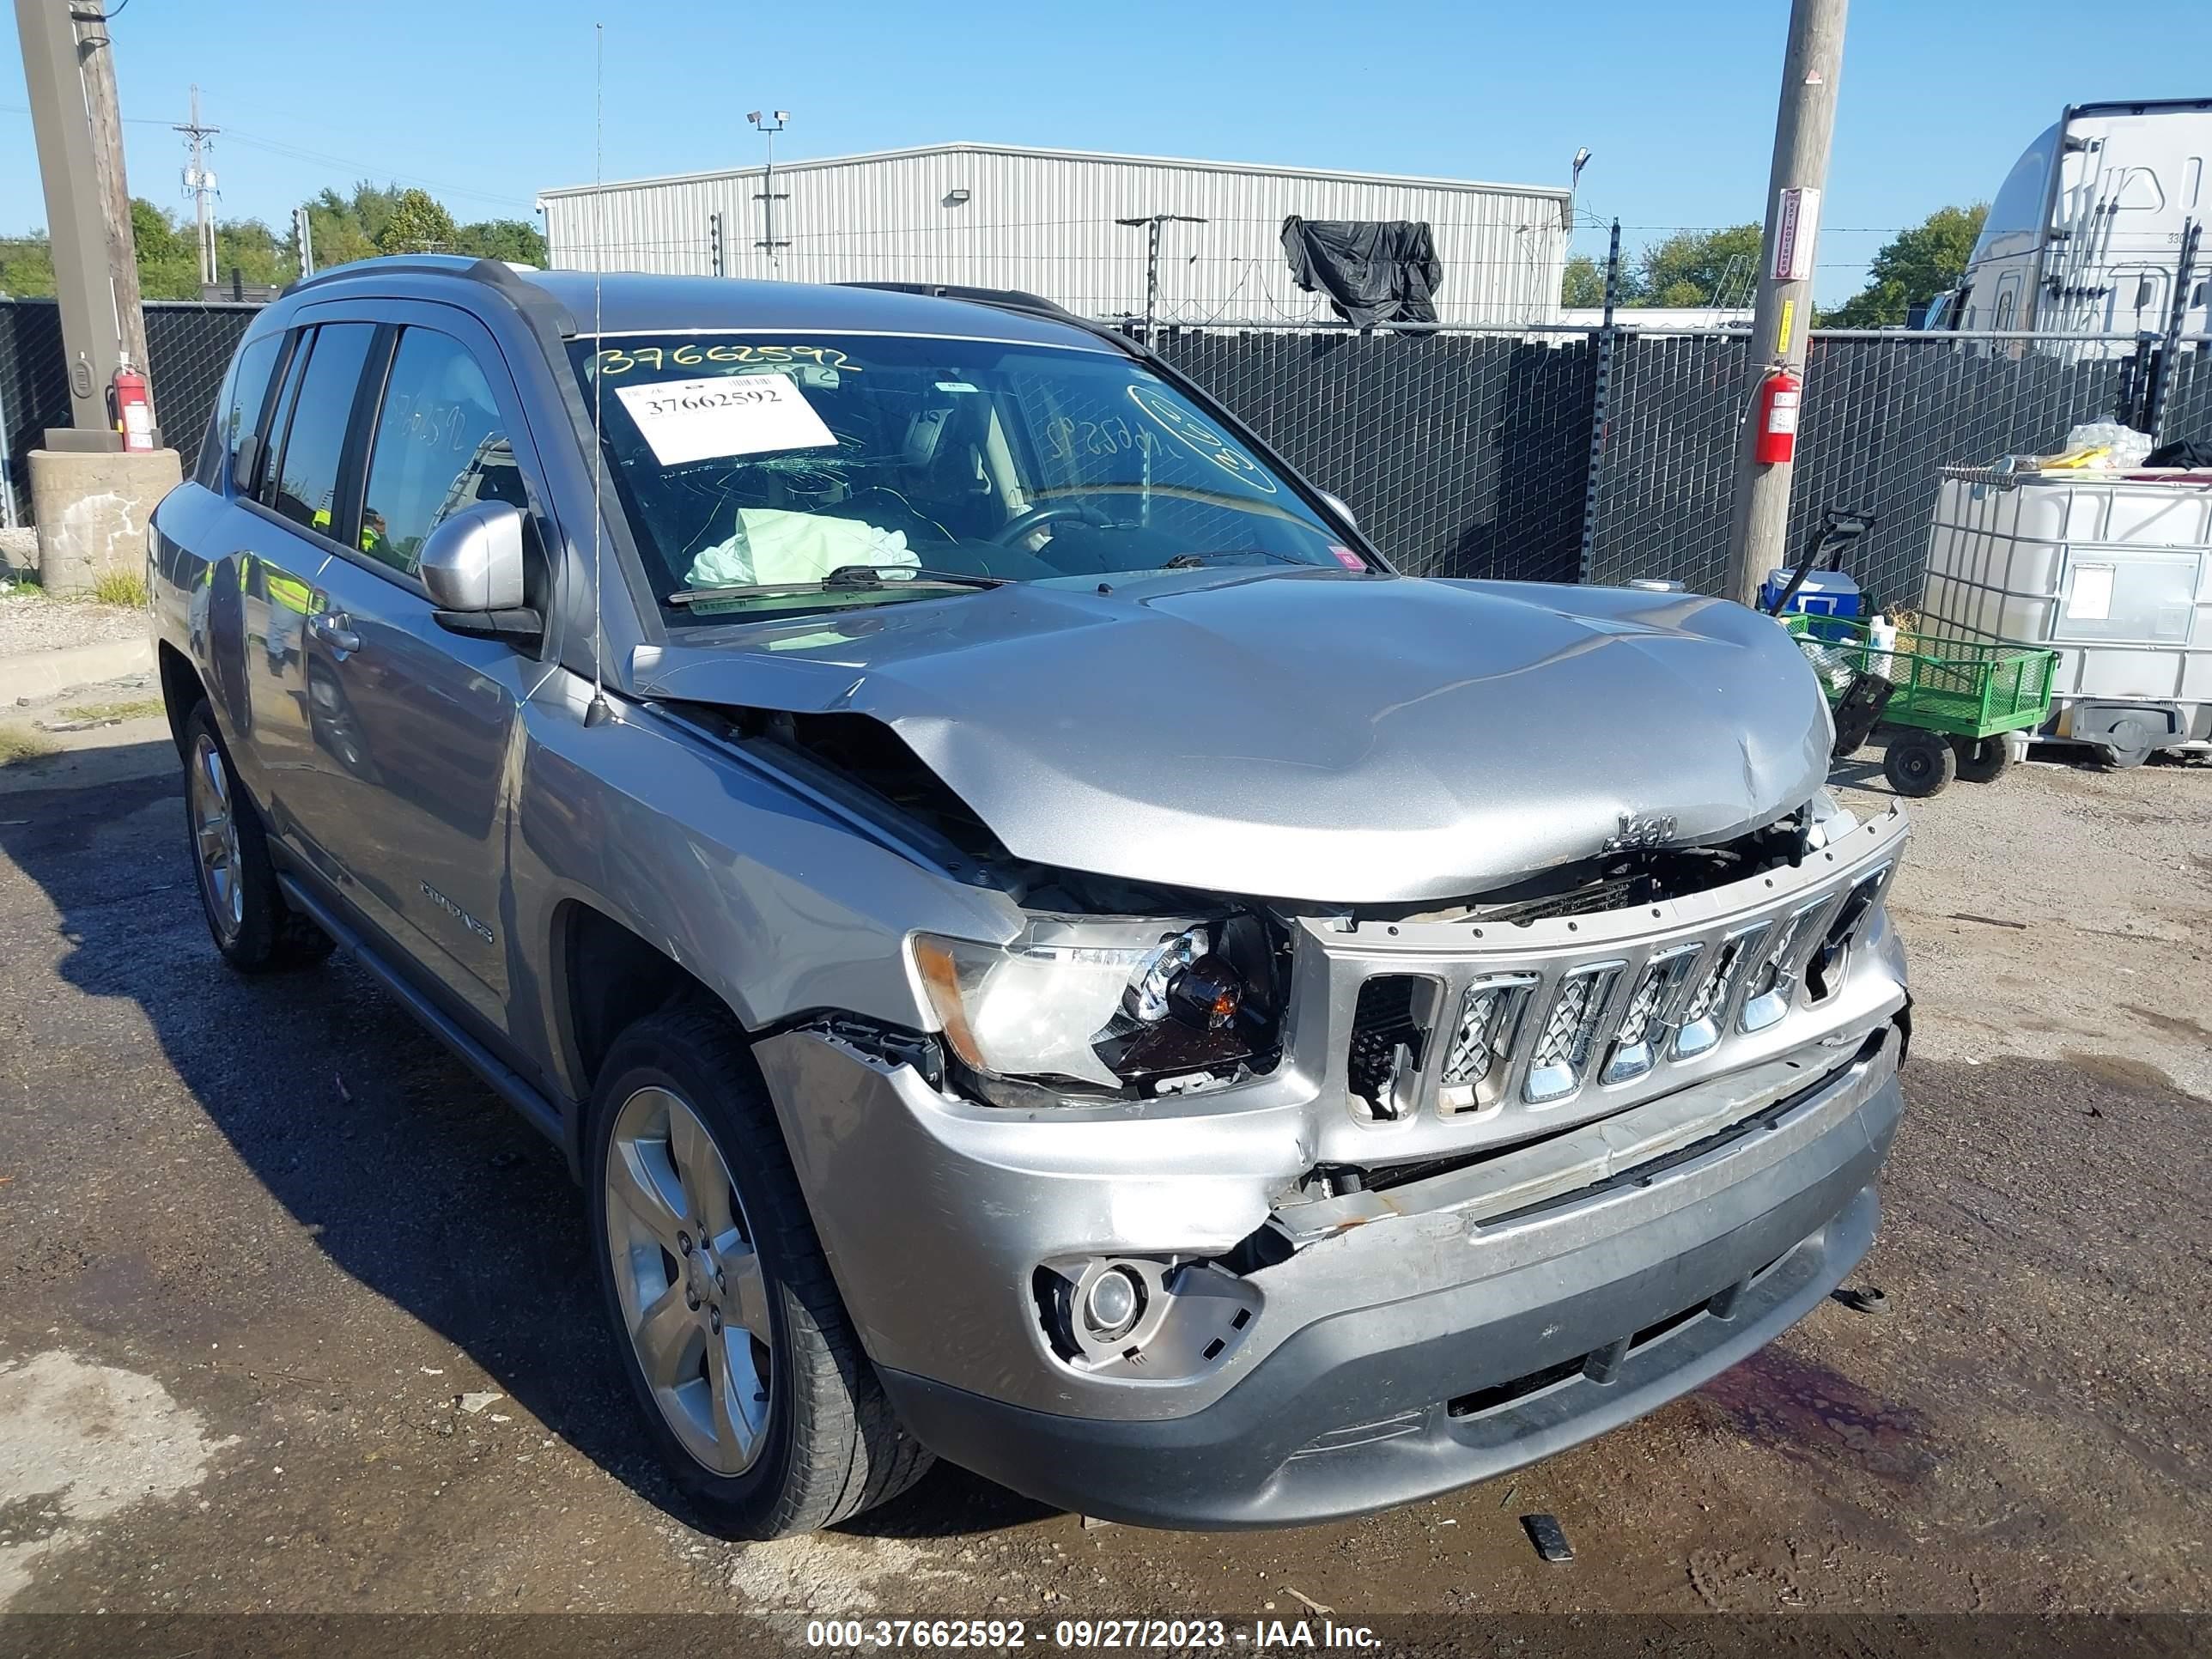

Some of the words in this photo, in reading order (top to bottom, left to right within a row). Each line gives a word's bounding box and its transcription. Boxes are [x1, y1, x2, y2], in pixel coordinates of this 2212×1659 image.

[1781, 202, 1794, 271] EXTINGUISHER
[599, 344, 863, 374] 37662592
[646, 390, 782, 416] 37662592
